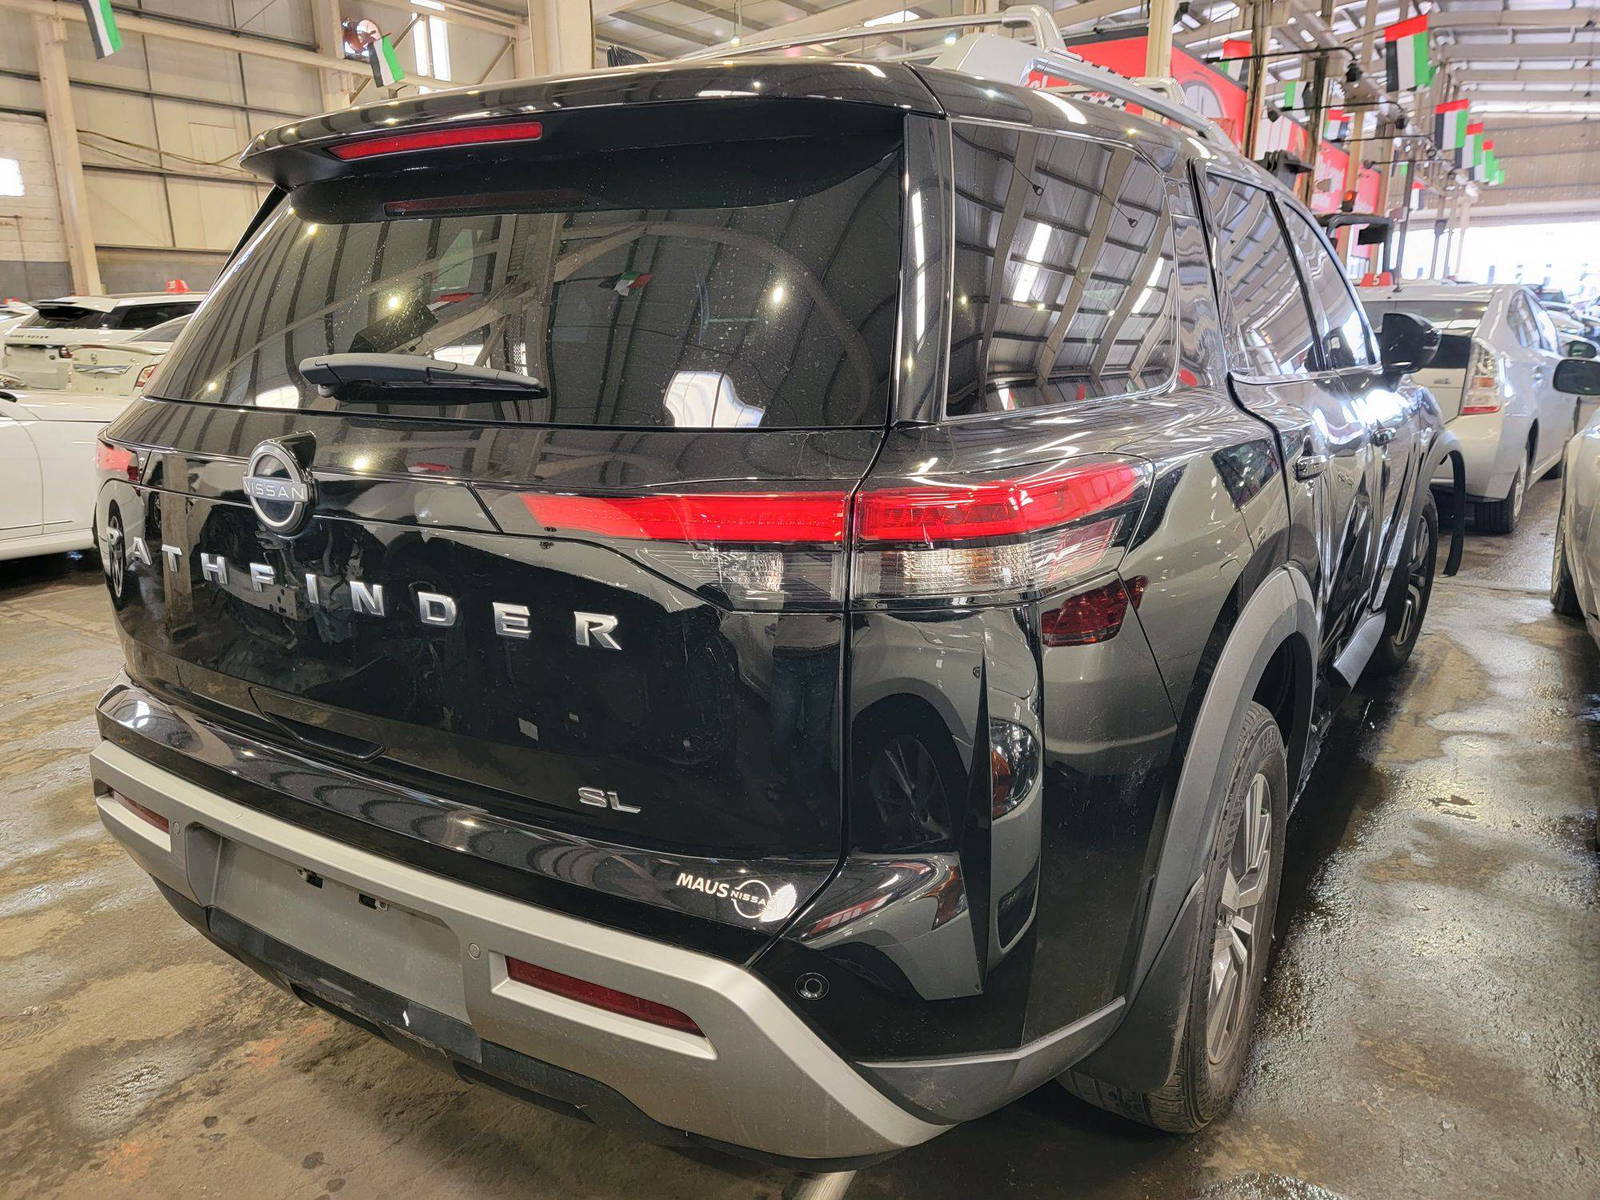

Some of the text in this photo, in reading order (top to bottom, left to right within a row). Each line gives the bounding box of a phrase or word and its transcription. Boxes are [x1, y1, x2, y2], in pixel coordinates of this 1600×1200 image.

[243, 479, 305, 500] NISSAN
[577, 786, 641, 814] SL
[675, 872, 770, 906] MAUS NISSA
